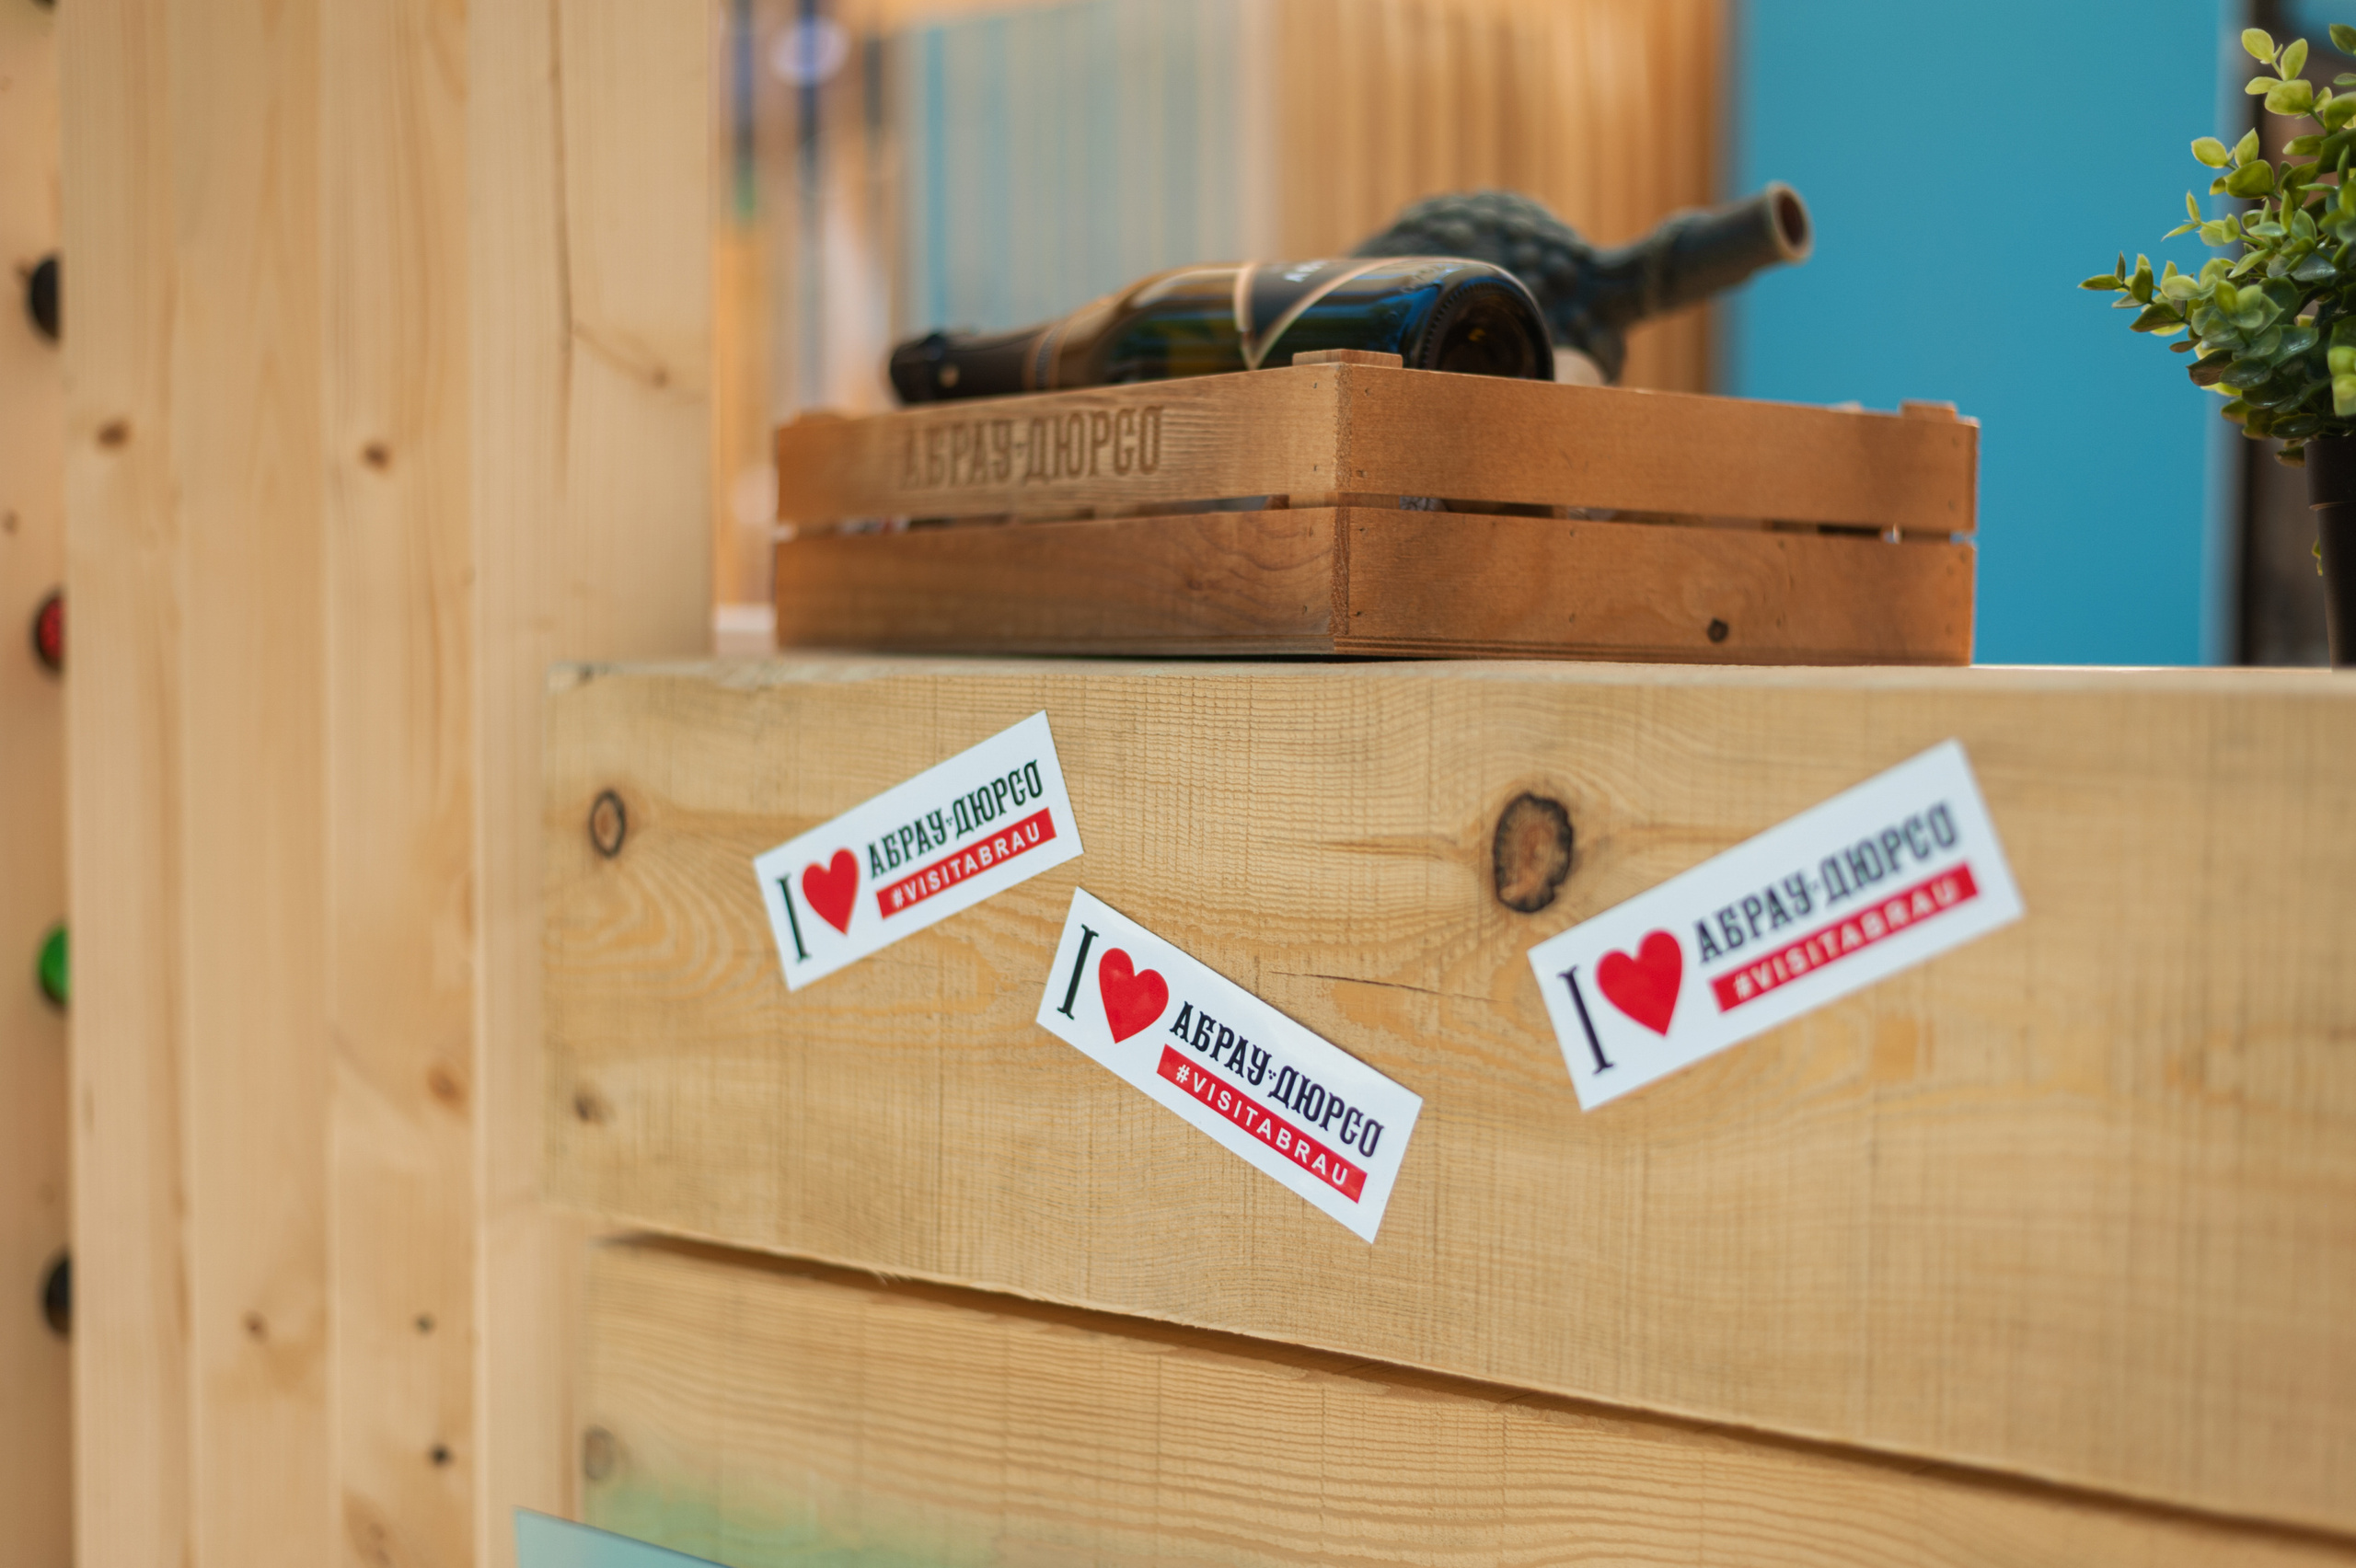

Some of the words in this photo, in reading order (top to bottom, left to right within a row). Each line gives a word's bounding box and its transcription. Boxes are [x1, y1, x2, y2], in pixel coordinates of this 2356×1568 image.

[891, 821, 1040, 909] #VISITABRAU
[776, 873, 812, 963] I
[1732, 875, 1959, 1001] #VISITABRAU
[1057, 923, 1099, 1020] I
[1557, 965, 1615, 1075] I
[1175, 1064, 1347, 1186] #VISITABRAU
